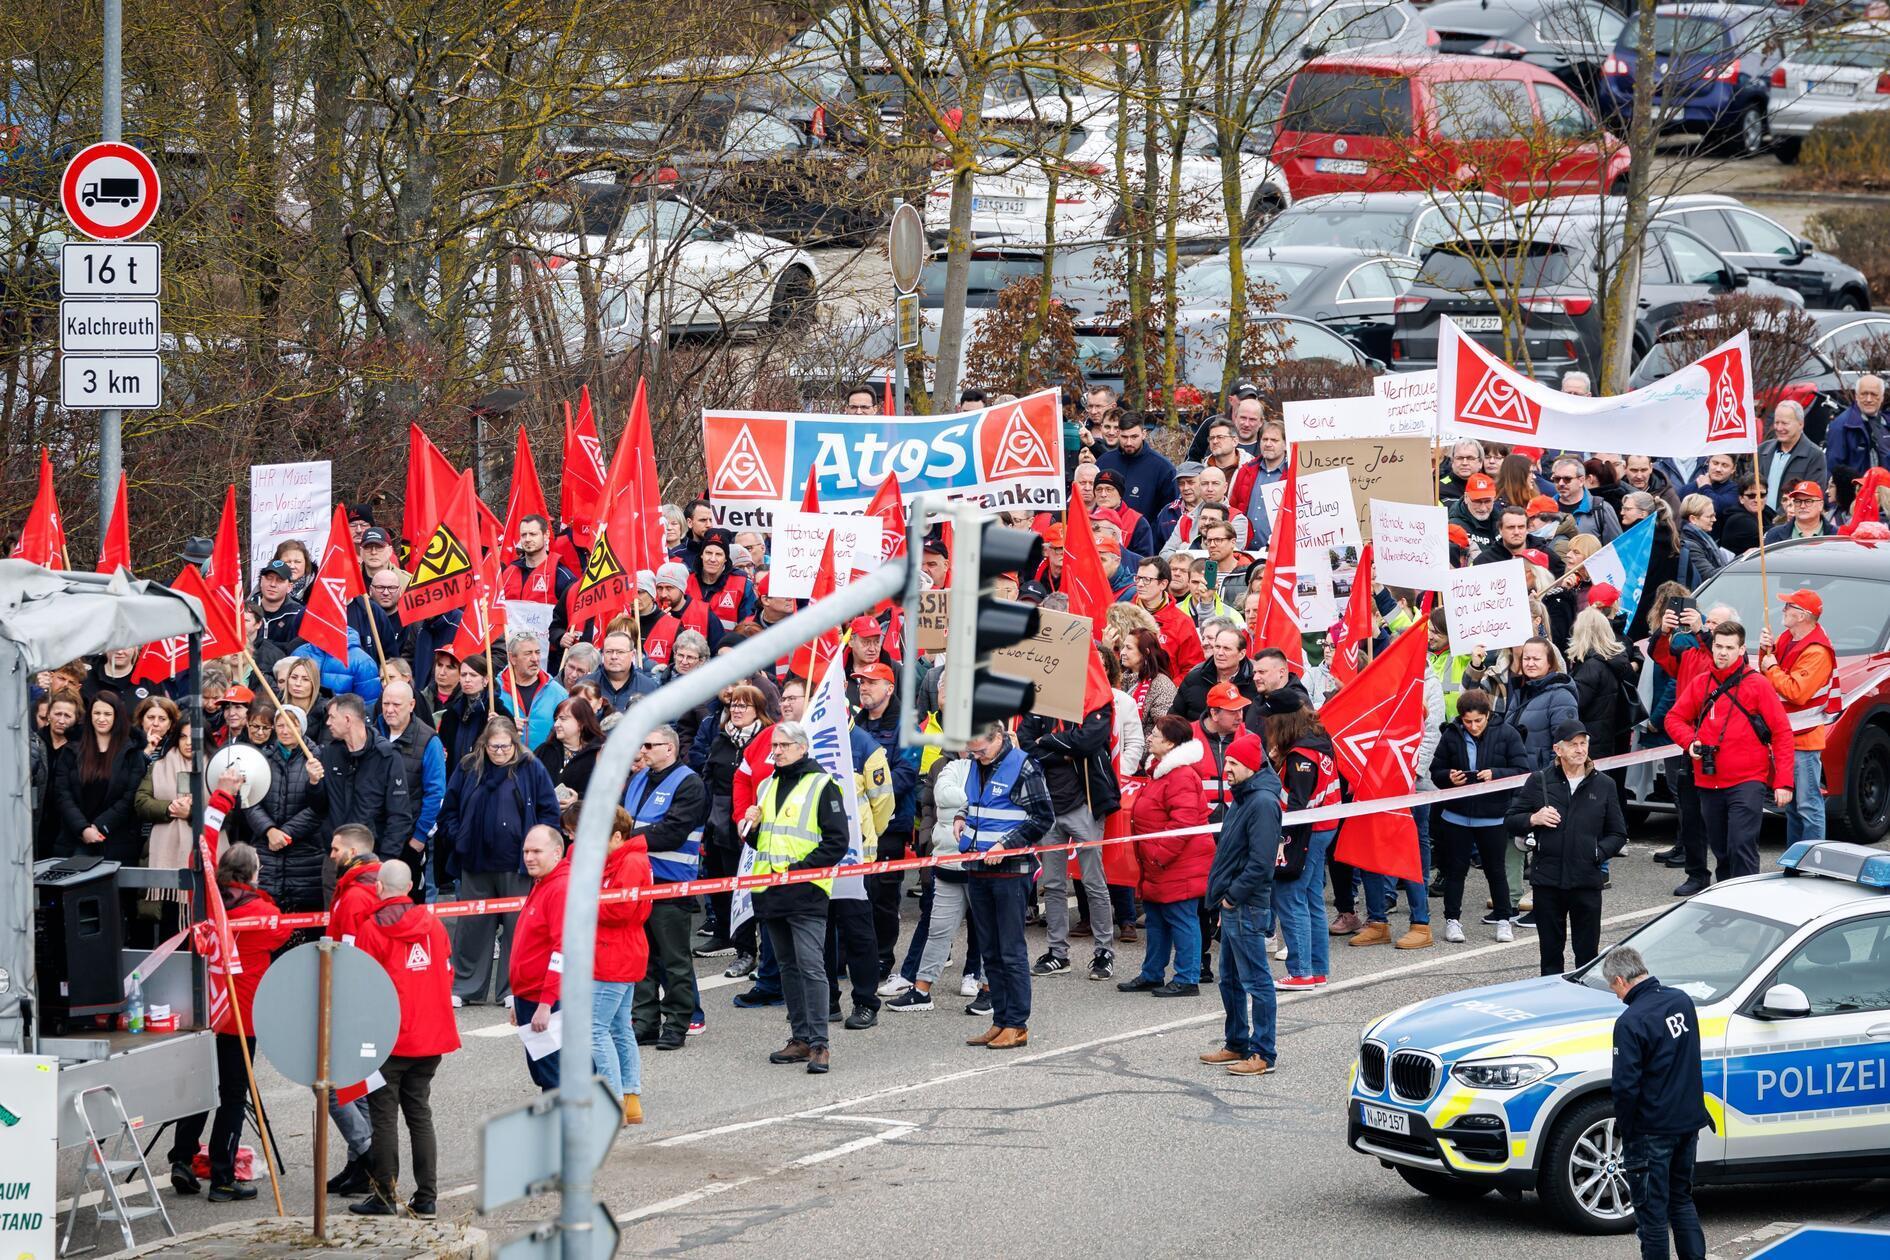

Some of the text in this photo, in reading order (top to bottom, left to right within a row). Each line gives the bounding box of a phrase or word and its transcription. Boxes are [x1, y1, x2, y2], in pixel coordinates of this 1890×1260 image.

[84, 254, 142, 284] 16 t
[67, 317, 159, 335] Kalchreuth
[1465, 318, 1478, 328] MU
[1480, 318, 1499, 328] 237
[83, 369, 140, 393] 3 km
[1303, 414, 1336, 428] Keine
[1300, 445, 1404, 472] Unsere Jobs
[1272, 484, 1312, 507] ONE
[1379, 512, 1404, 529] Hände
[784, 523, 825, 541] Hände
[787, 547, 805, 558] von
[1451, 578, 1482, 598] Hände
[1665, 1012, 1689, 1039] BR
[1757, 1058, 1885, 1101] POLIZEI
[1389, 1113, 1404, 1131] 157
[0, 1213, 43, 1231] TAND
